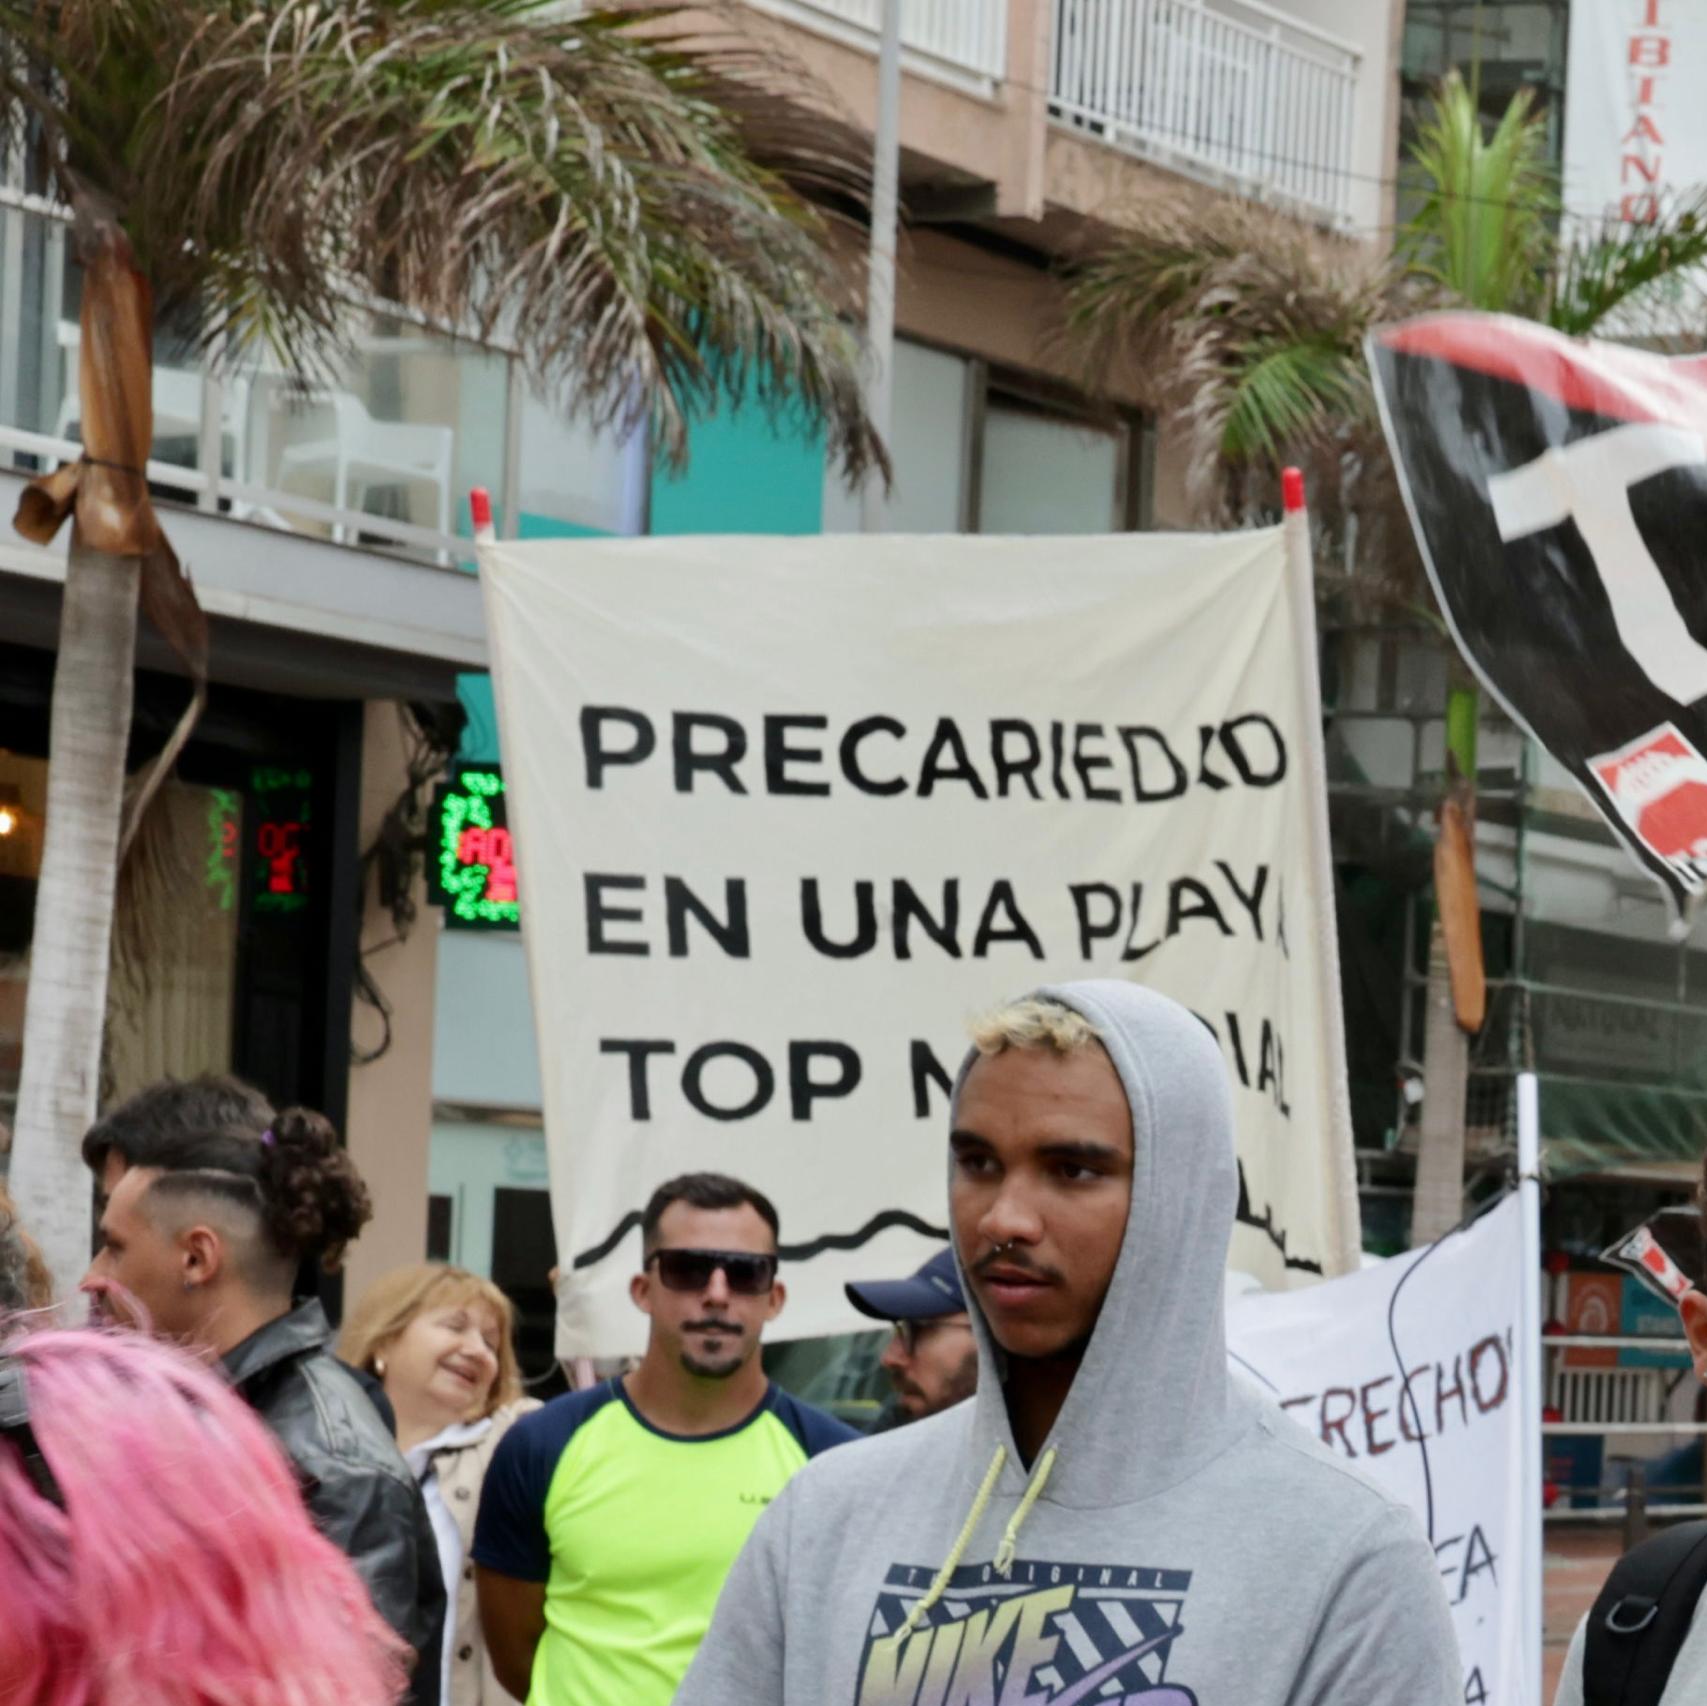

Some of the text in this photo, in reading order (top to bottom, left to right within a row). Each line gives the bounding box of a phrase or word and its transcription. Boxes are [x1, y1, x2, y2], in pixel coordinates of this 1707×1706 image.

[583, 872, 750, 958] EN
[801, 878, 1045, 961] UNA
[600, 1038, 863, 1123] TOP
